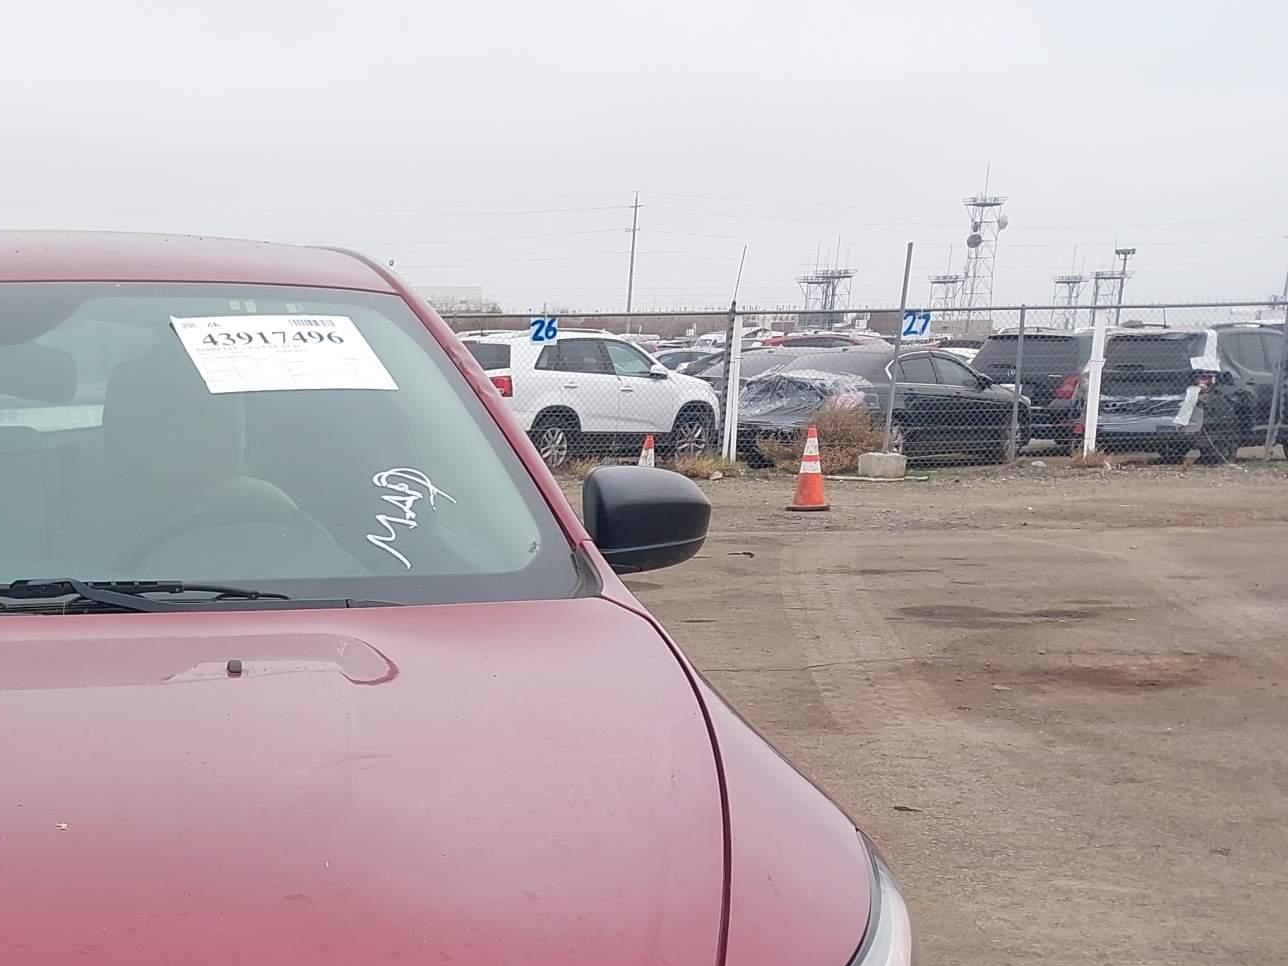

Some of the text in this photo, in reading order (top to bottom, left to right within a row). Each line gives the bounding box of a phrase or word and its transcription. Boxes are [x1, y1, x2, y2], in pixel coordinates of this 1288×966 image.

[531, 317, 557, 341] 26
[902, 311, 931, 336] 27
[202, 330, 345, 347] 43917496
